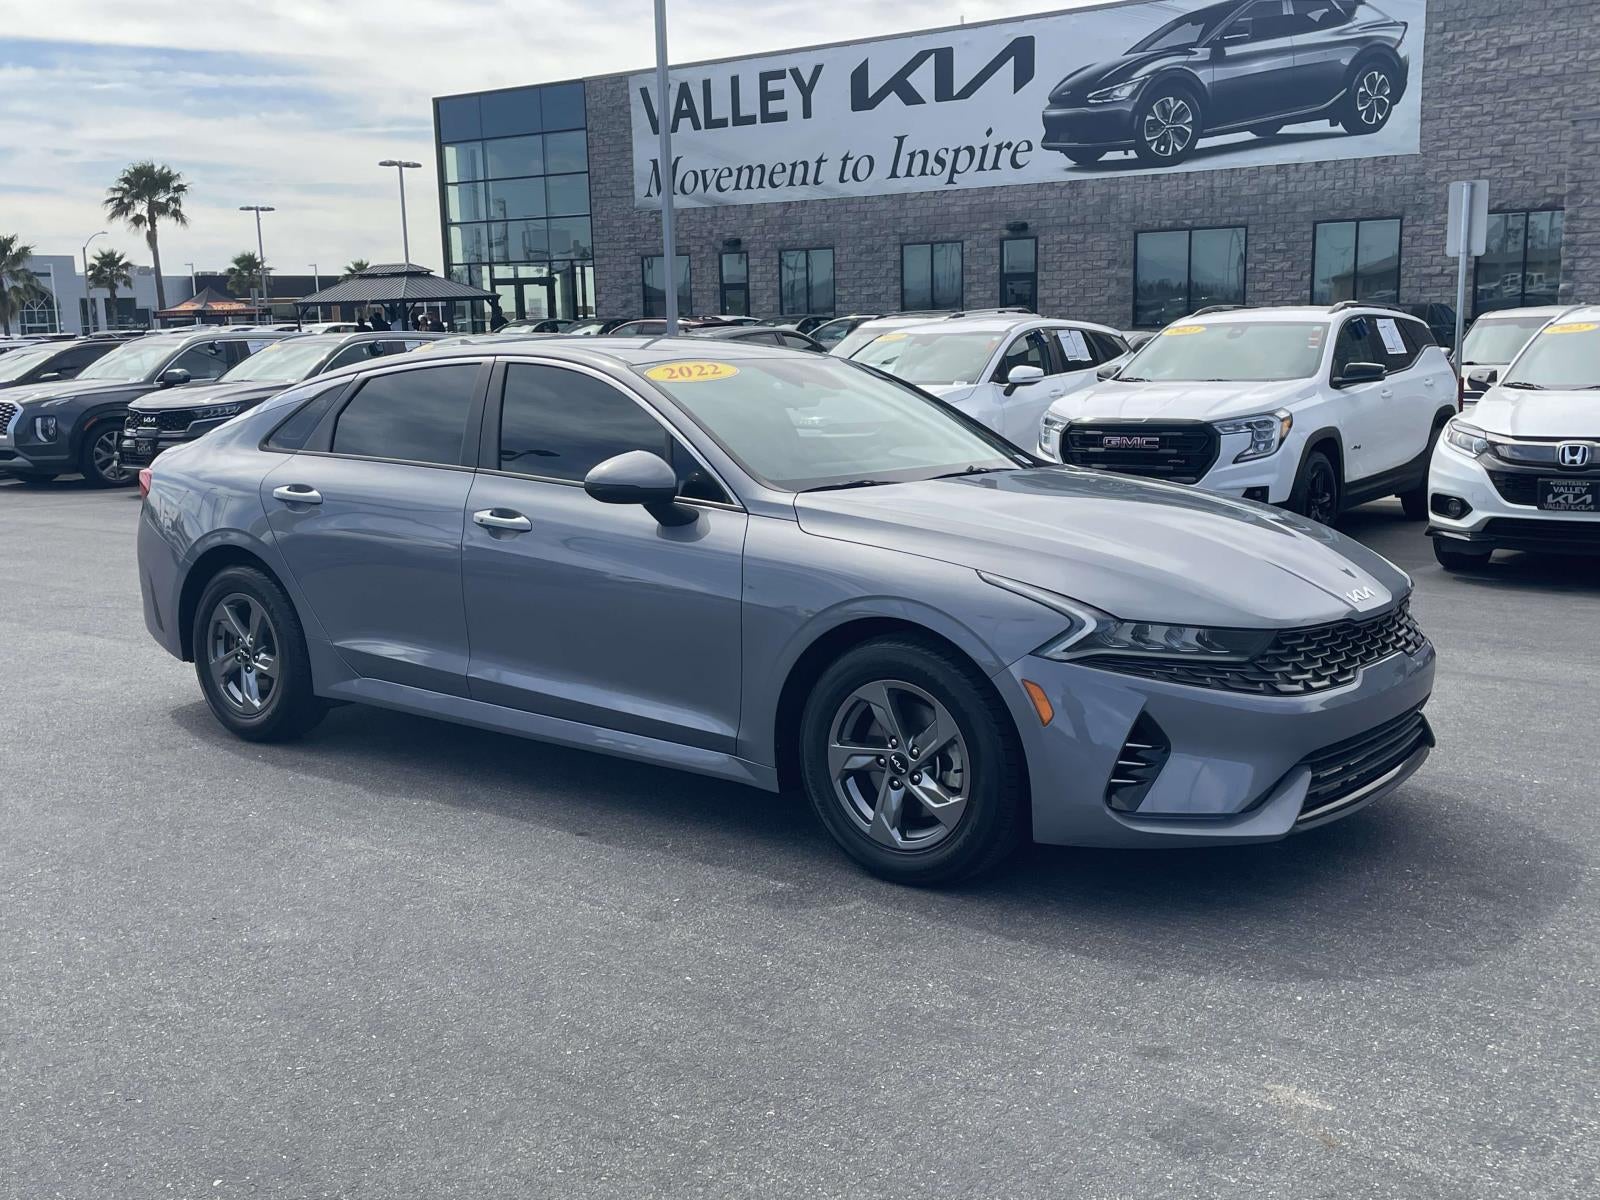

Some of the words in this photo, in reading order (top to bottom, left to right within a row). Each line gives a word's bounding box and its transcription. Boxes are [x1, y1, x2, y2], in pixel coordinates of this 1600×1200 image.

[639, 63, 825, 136] VALLEY
[644, 152, 828, 198] Movement
[838, 150, 875, 184] to
[886, 126, 1034, 186] Inspire
[663, 363, 722, 379] 2022
[1103, 436, 1160, 449] GMC
